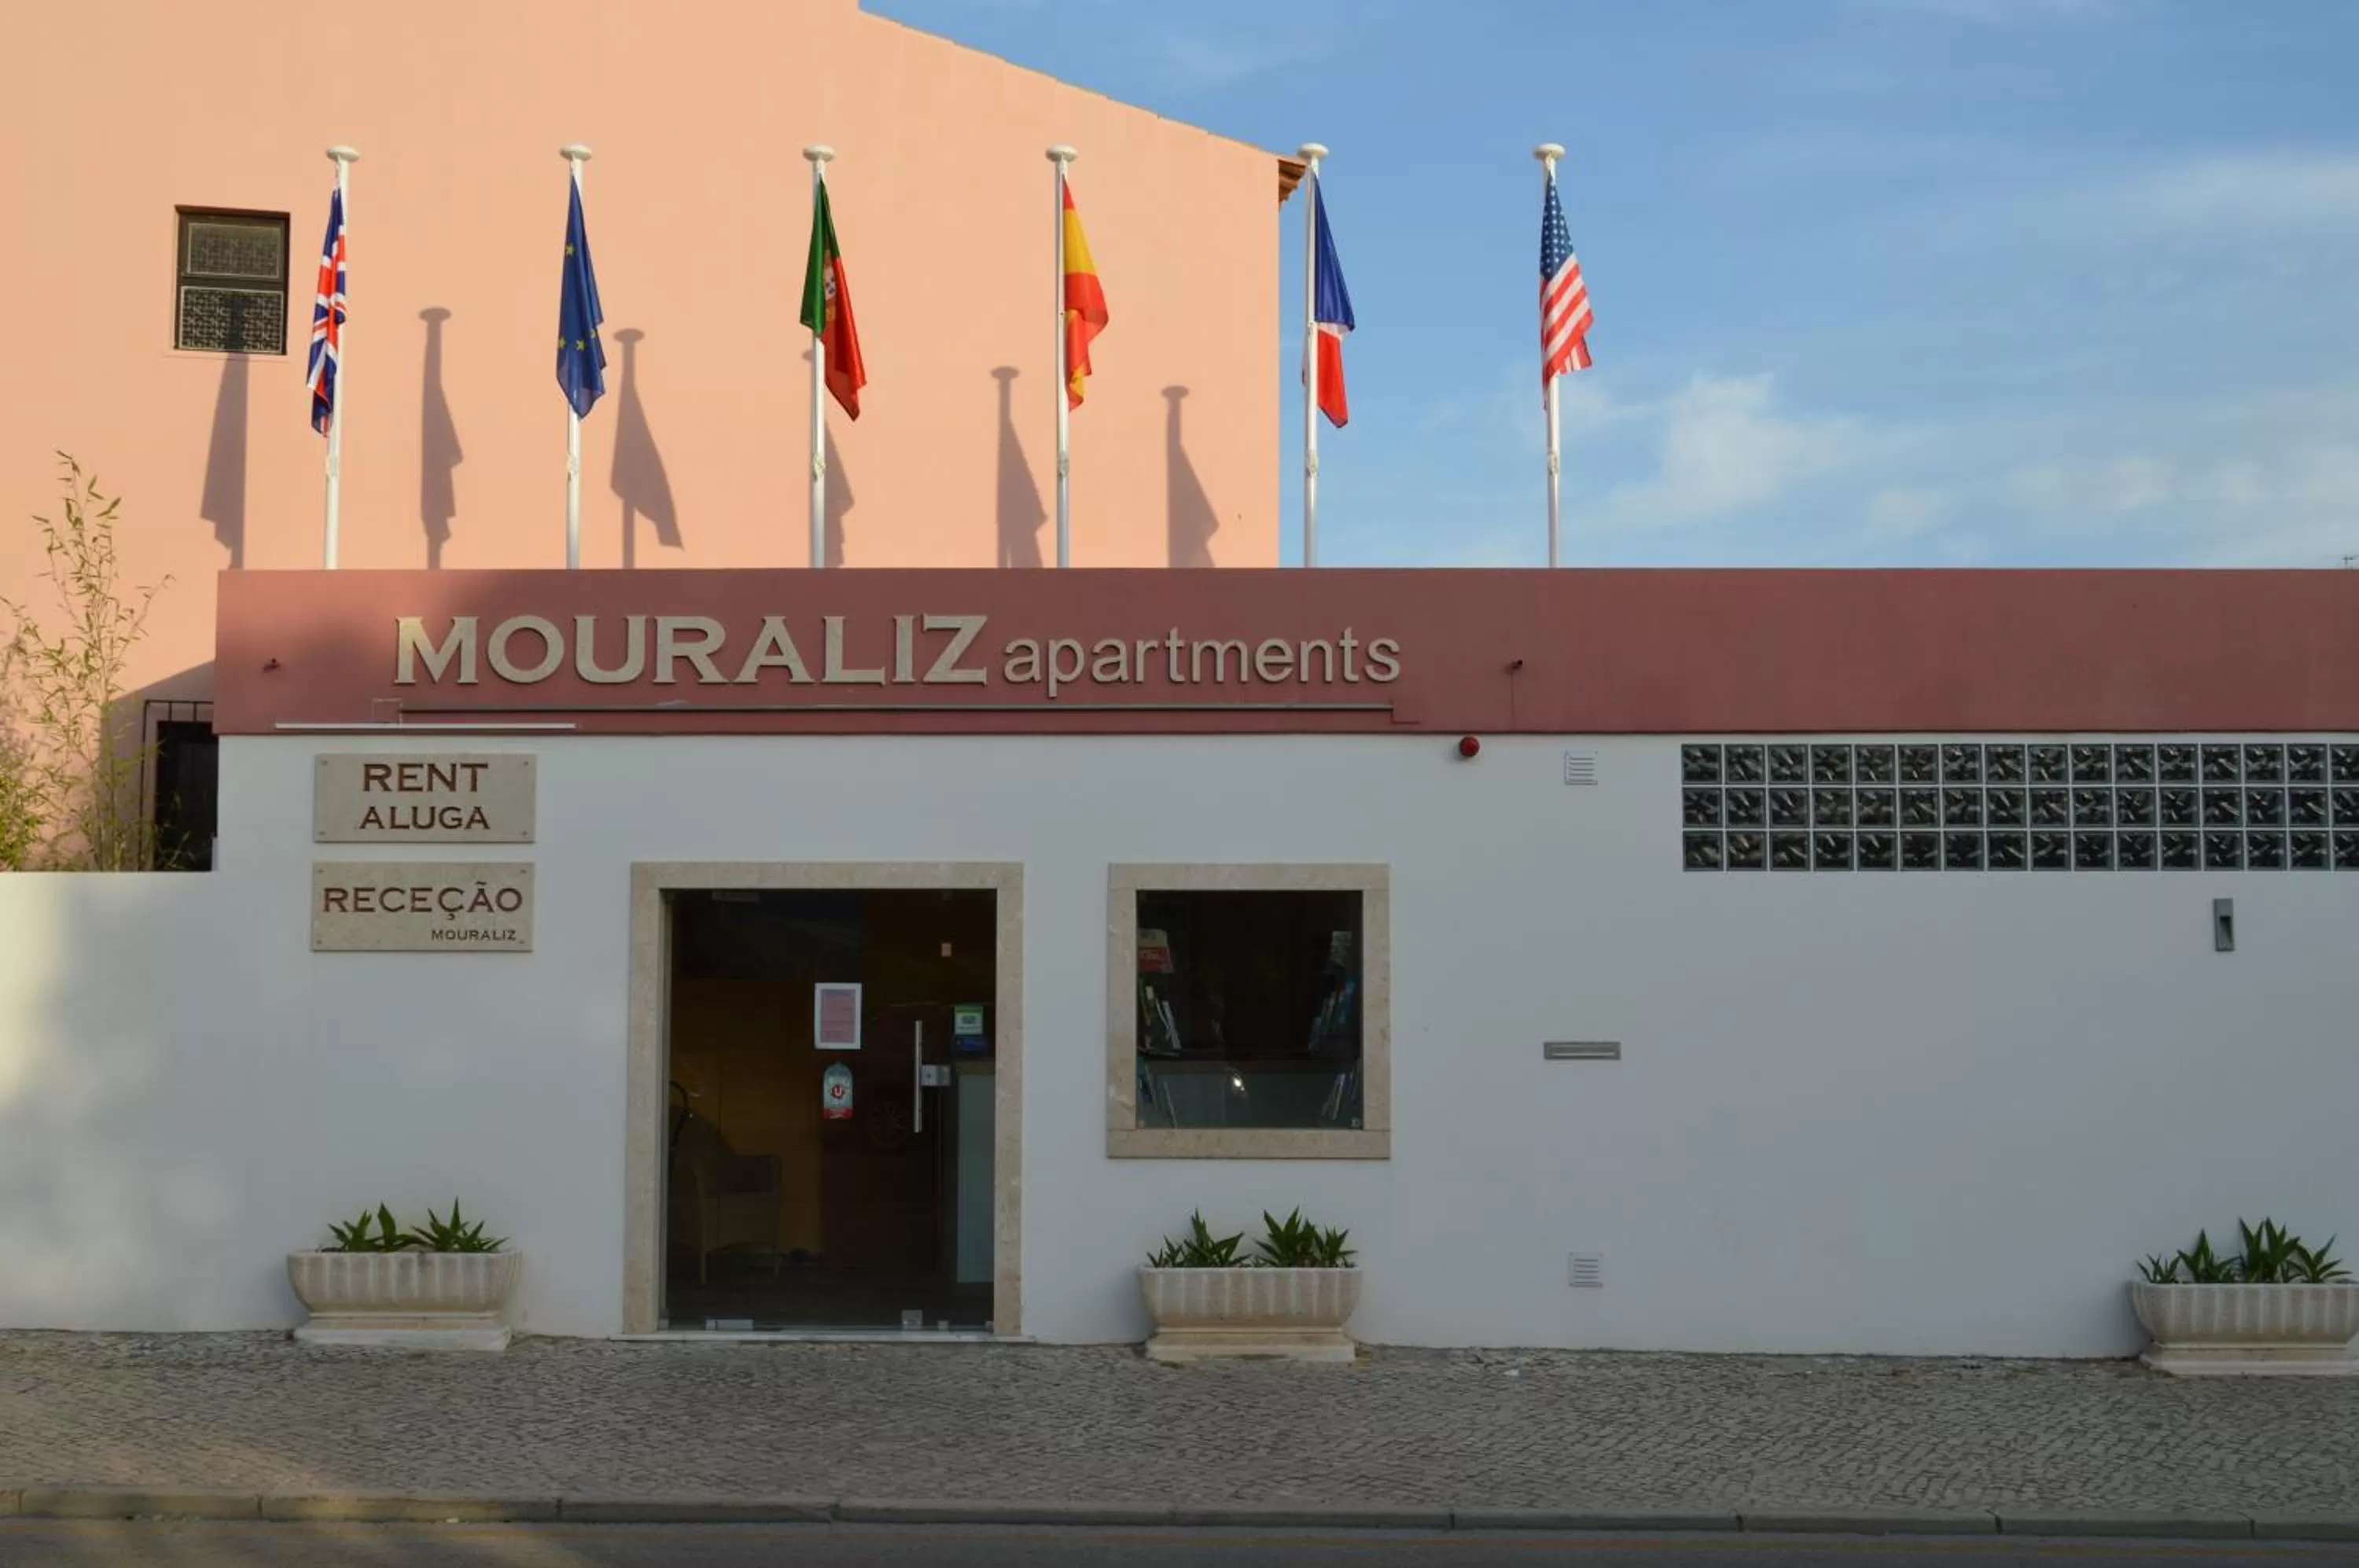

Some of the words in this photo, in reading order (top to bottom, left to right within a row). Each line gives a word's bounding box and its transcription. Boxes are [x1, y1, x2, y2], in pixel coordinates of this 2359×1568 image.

[394, 614, 988, 686] MOURALIZ
[1003, 627, 1400, 698] apartments
[362, 763, 488, 793] RENT
[359, 805, 491, 830] ALUGA
[322, 880, 523, 921] RECEÇÃO
[430, 929, 517, 942] MOURALIZ
